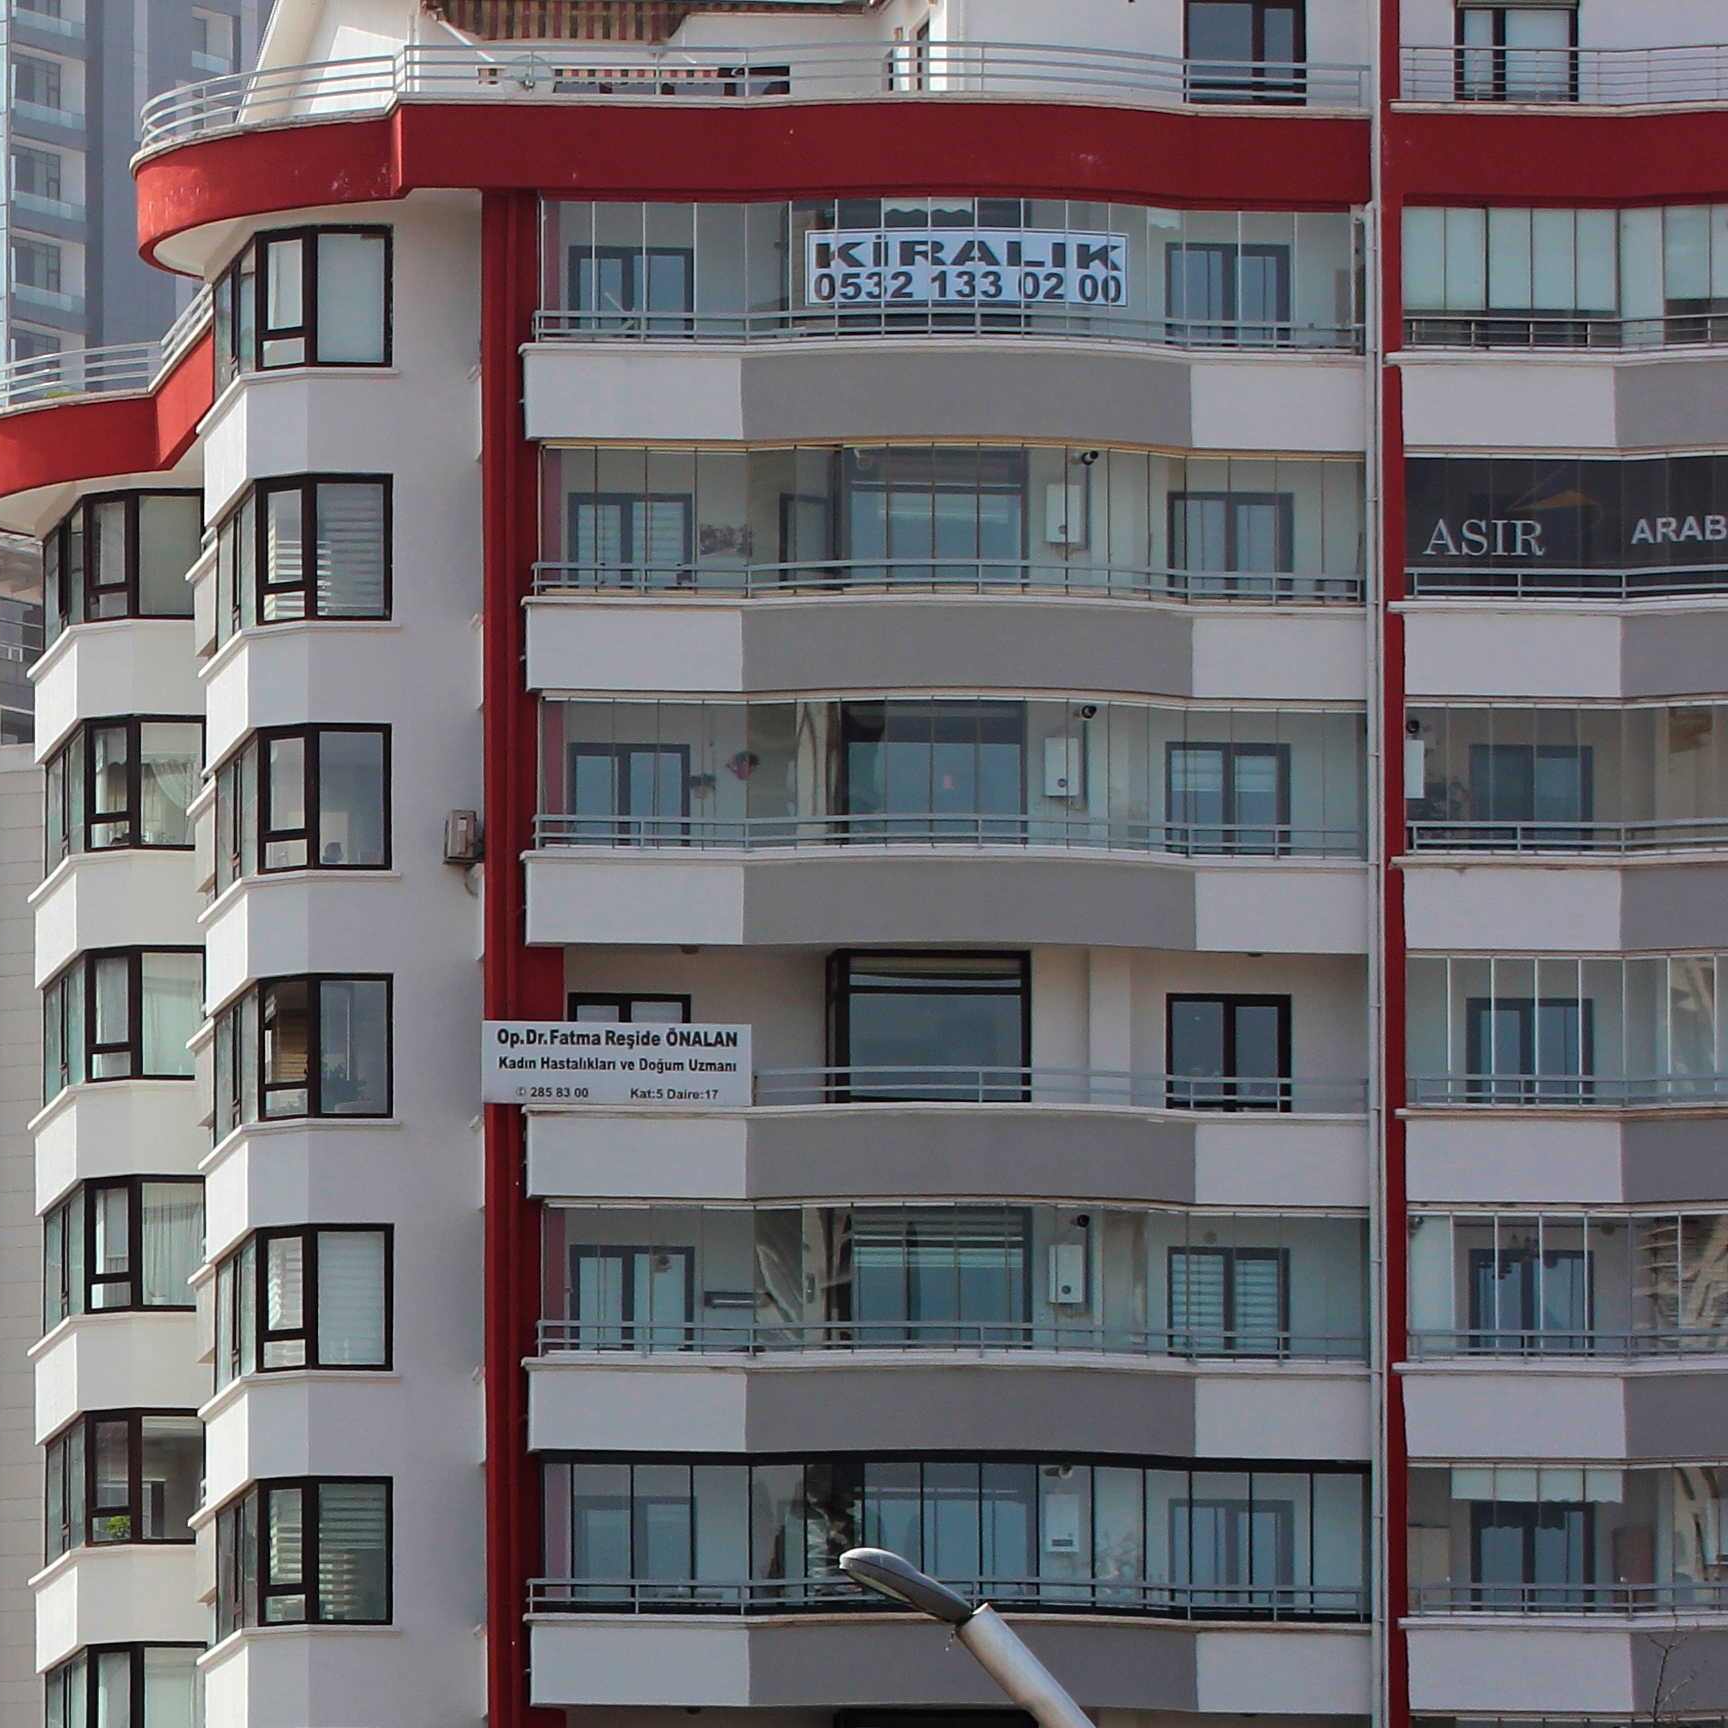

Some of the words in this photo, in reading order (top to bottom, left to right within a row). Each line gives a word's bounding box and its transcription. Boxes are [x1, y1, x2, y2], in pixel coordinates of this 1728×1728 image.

[814, 234, 1123, 271] KİRALIK
[814, 271, 914, 301] 0532
[930, 271, 1003, 299] 133
[1018, 272, 1065, 300] 02
[1079, 274, 1122, 304] 00
[1422, 518, 1544, 557] ASIR
[604, 1030, 661, 1050] Reşide
[665, 1027, 739, 1047] ÖNALAN
[498, 1056, 537, 1070] Kadın
[539, 1057, 617, 1071] Hastalıkları
[620, 1061, 635, 1071] ve
[639, 1058, 685, 1074] Doğum
[688, 1059, 737, 1072] Uzmanı
[530, 1086, 553, 1098] 285
[555, 1086, 571, 1098] 83
[574, 1086, 589, 1098] 00
[630, 1088, 663, 1100] Kat:5
[666, 1089, 719, 1100] Daire:17
